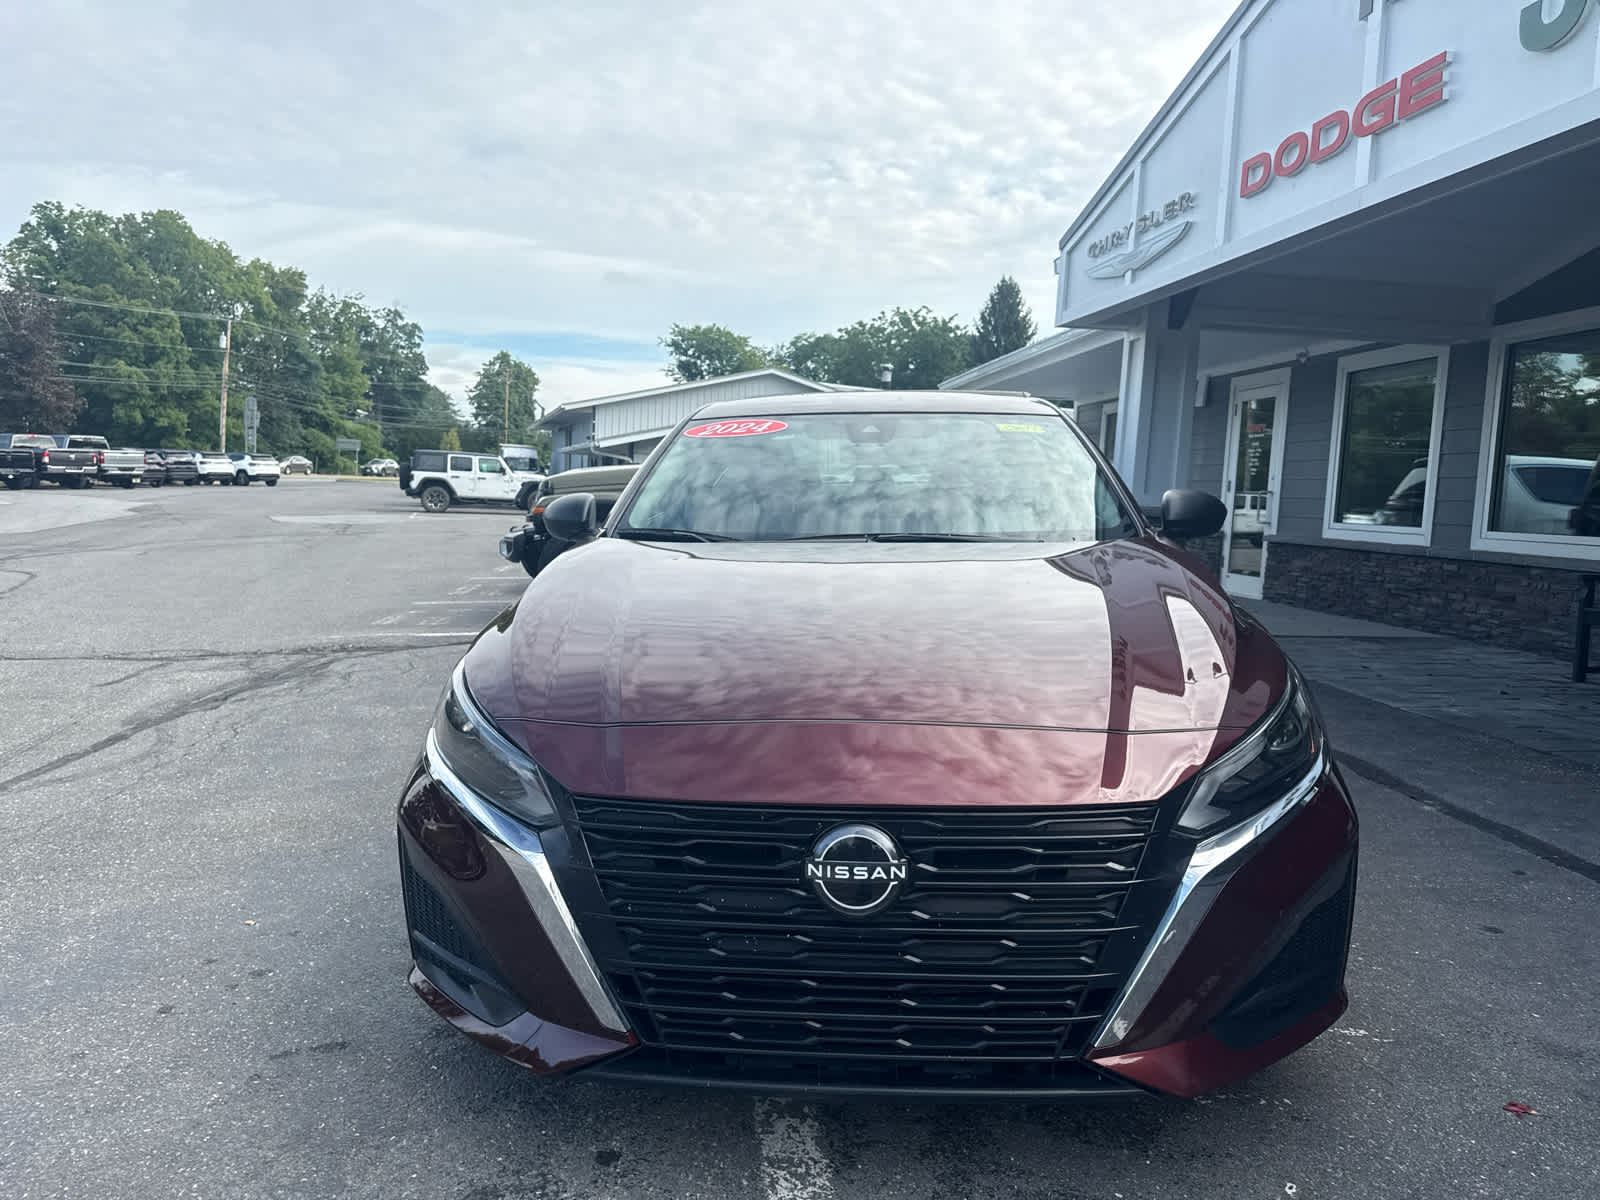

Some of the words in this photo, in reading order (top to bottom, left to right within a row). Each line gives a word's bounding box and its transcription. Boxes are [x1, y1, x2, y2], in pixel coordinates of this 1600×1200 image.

[1239, 50, 1452, 199] DODGE
[1087, 191, 1195, 258] CHRYSLER
[698, 421, 774, 436] 2024
[807, 863, 906, 880] NISSAN
